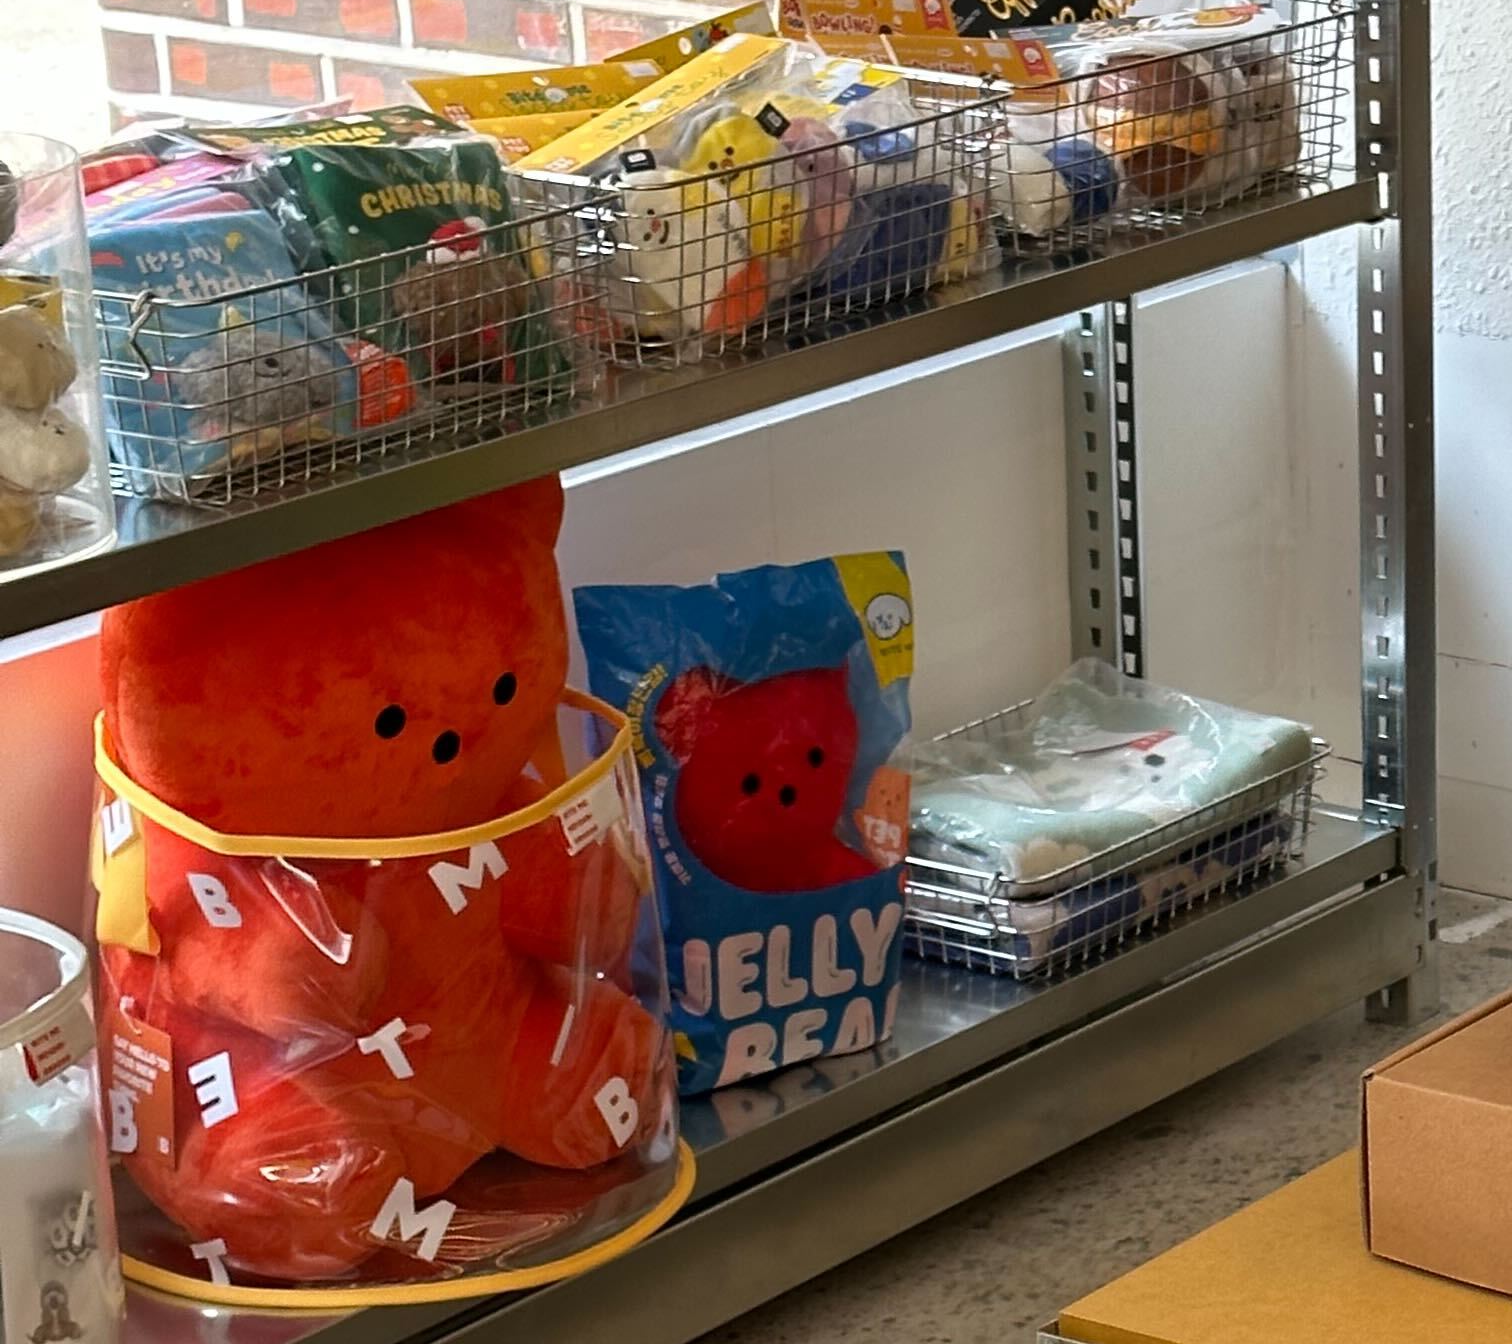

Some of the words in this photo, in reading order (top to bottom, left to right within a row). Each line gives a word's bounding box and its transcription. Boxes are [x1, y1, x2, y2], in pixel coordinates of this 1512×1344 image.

[360, 182, 503, 220] CHRISTMAS
[137, 251, 185, 275] It's
[188, 244, 223, 266] my
[187, 872, 242, 928] B
[680, 902, 902, 1021] JELLY
[356, 1017, 415, 1080] T
[593, 1076, 638, 1148] B
[369, 1177, 457, 1262] M
